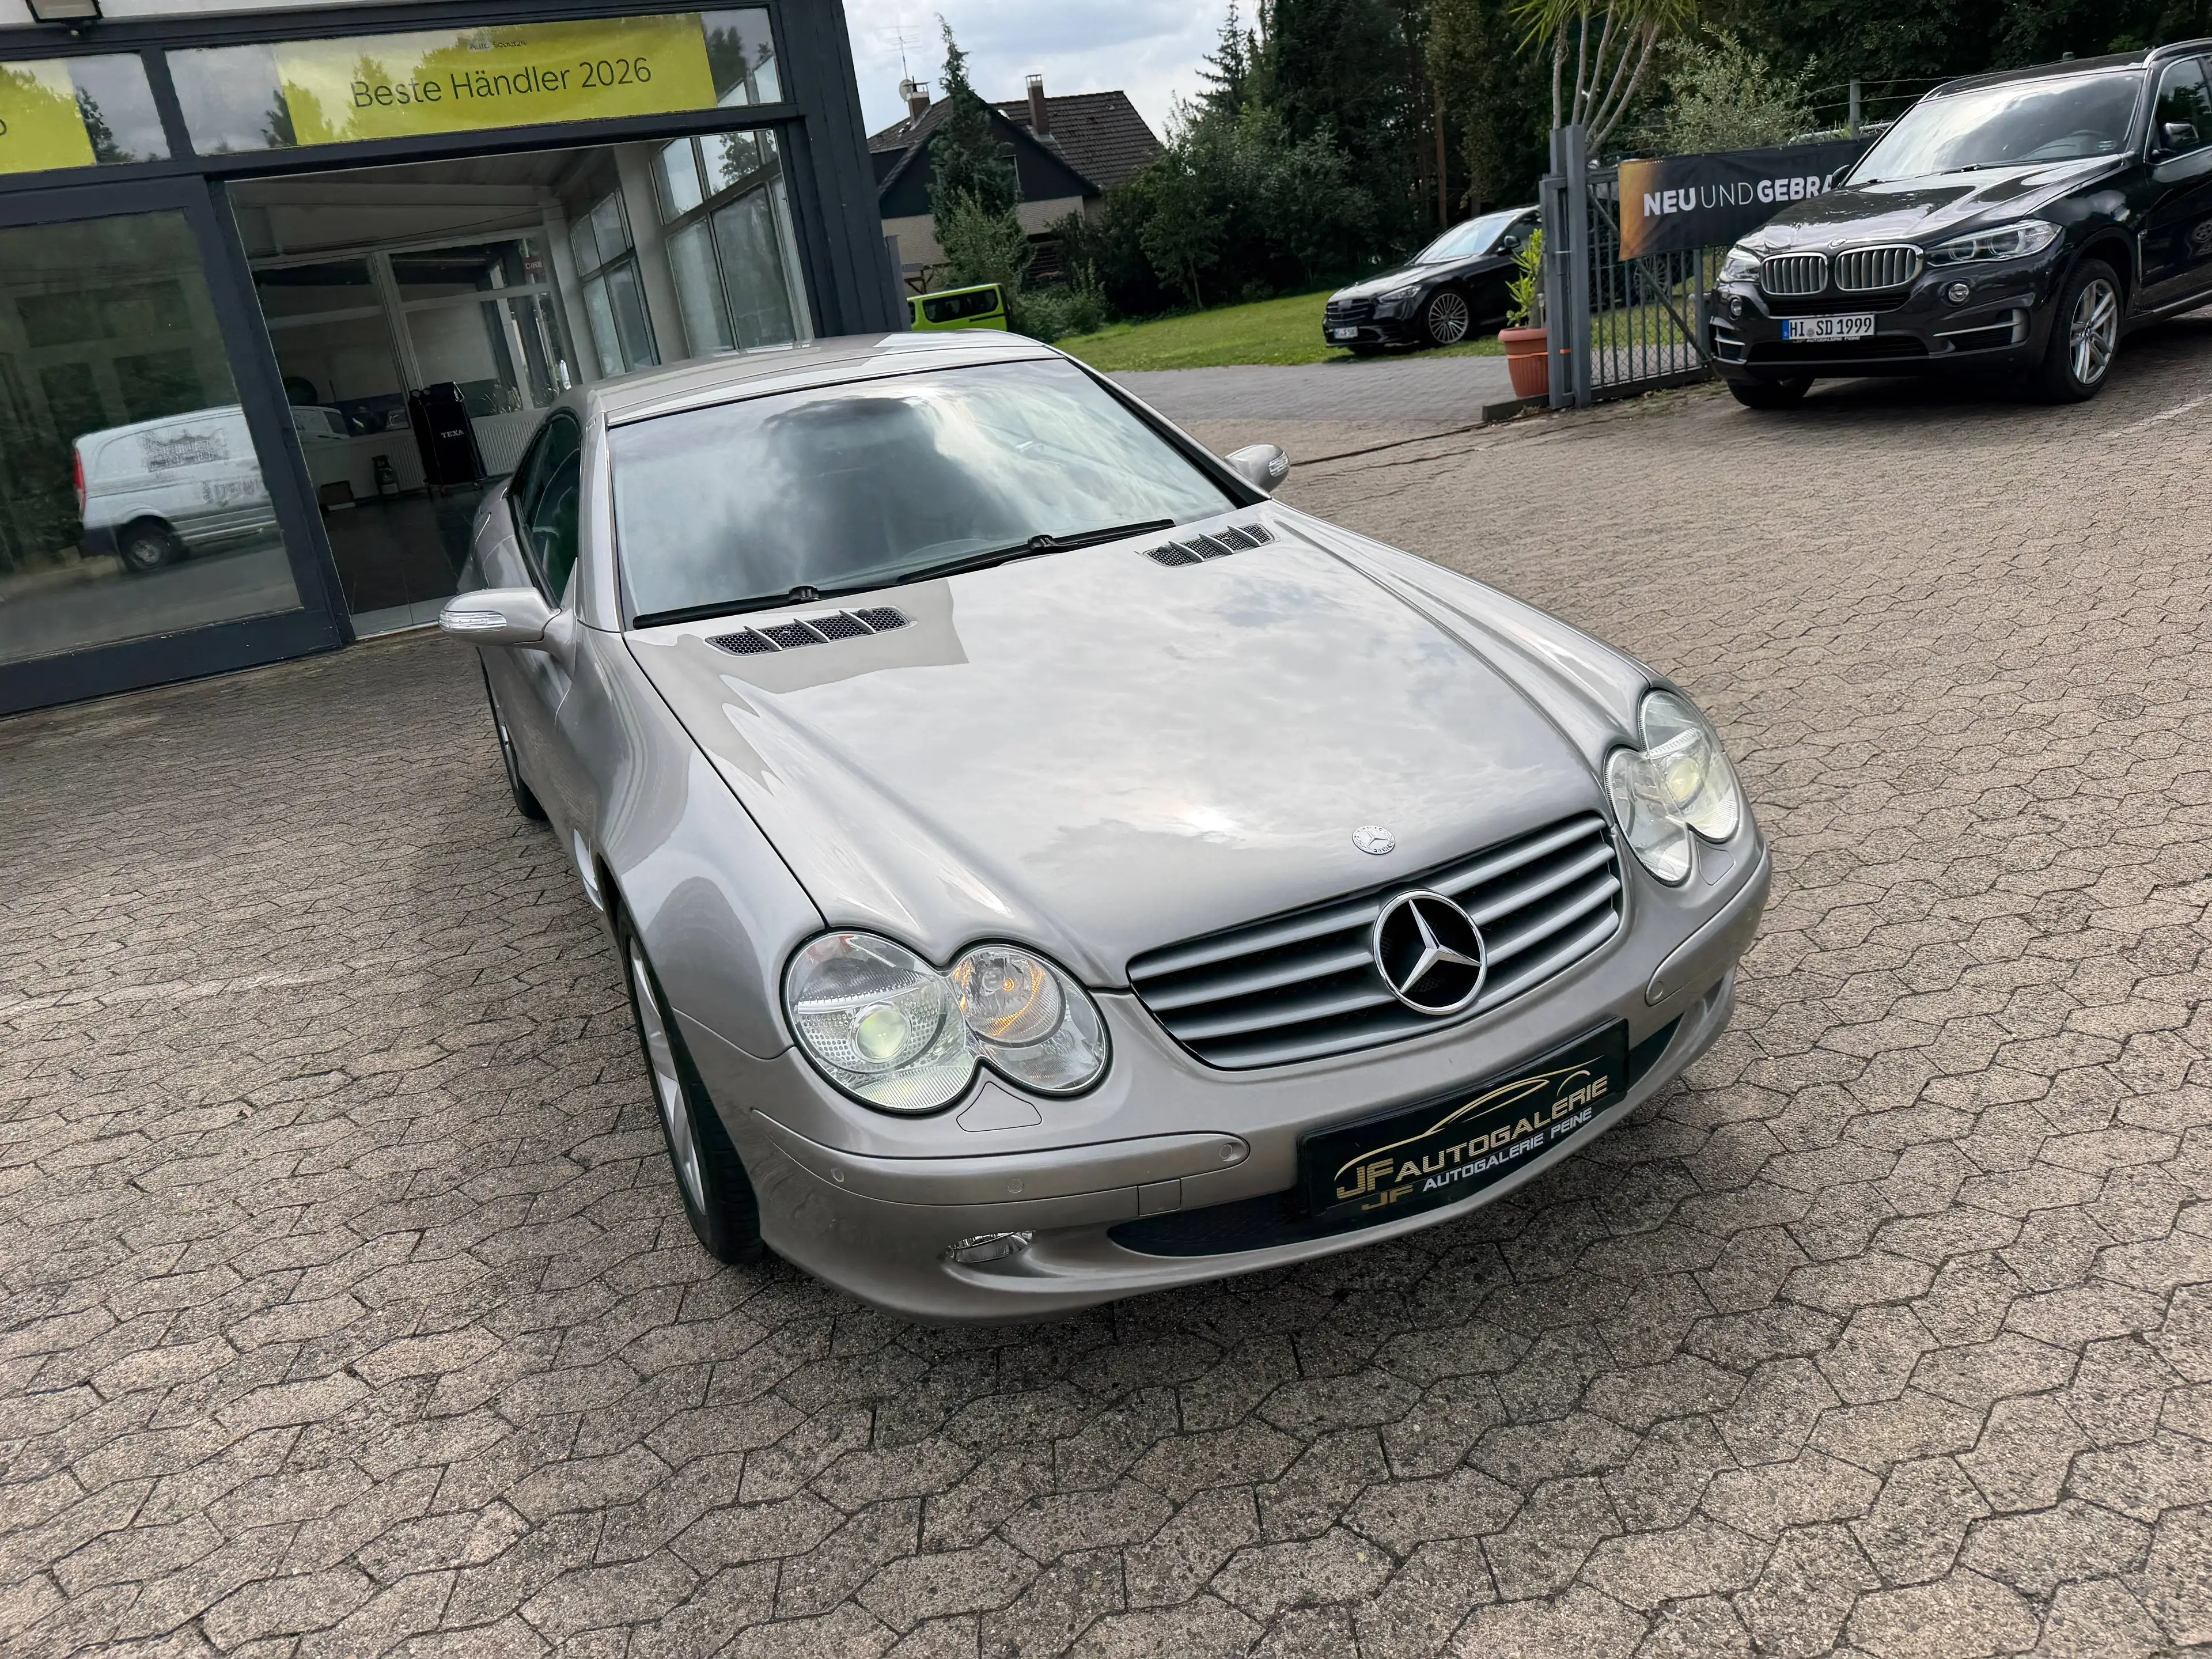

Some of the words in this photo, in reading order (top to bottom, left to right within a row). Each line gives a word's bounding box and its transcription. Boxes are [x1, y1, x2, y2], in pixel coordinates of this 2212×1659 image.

[350, 79, 442, 108] Beste
[451, 66, 570, 99] Händler
[579, 58, 652, 88] 2026
[1790, 321, 1804, 337] HI
[1816, 320, 1832, 335] SD
[1836, 317, 1872, 334] 1999
[441, 429, 464, 438] TEXA
[1336, 1158, 1393, 1199] JF
[1395, 1075, 1608, 1182] AUTOGALERIE
[1362, 1184, 1414, 1210] JF
[1423, 1135, 1544, 1192] AUTOGALERIE
[1551, 1107, 1592, 1139] PEINE
